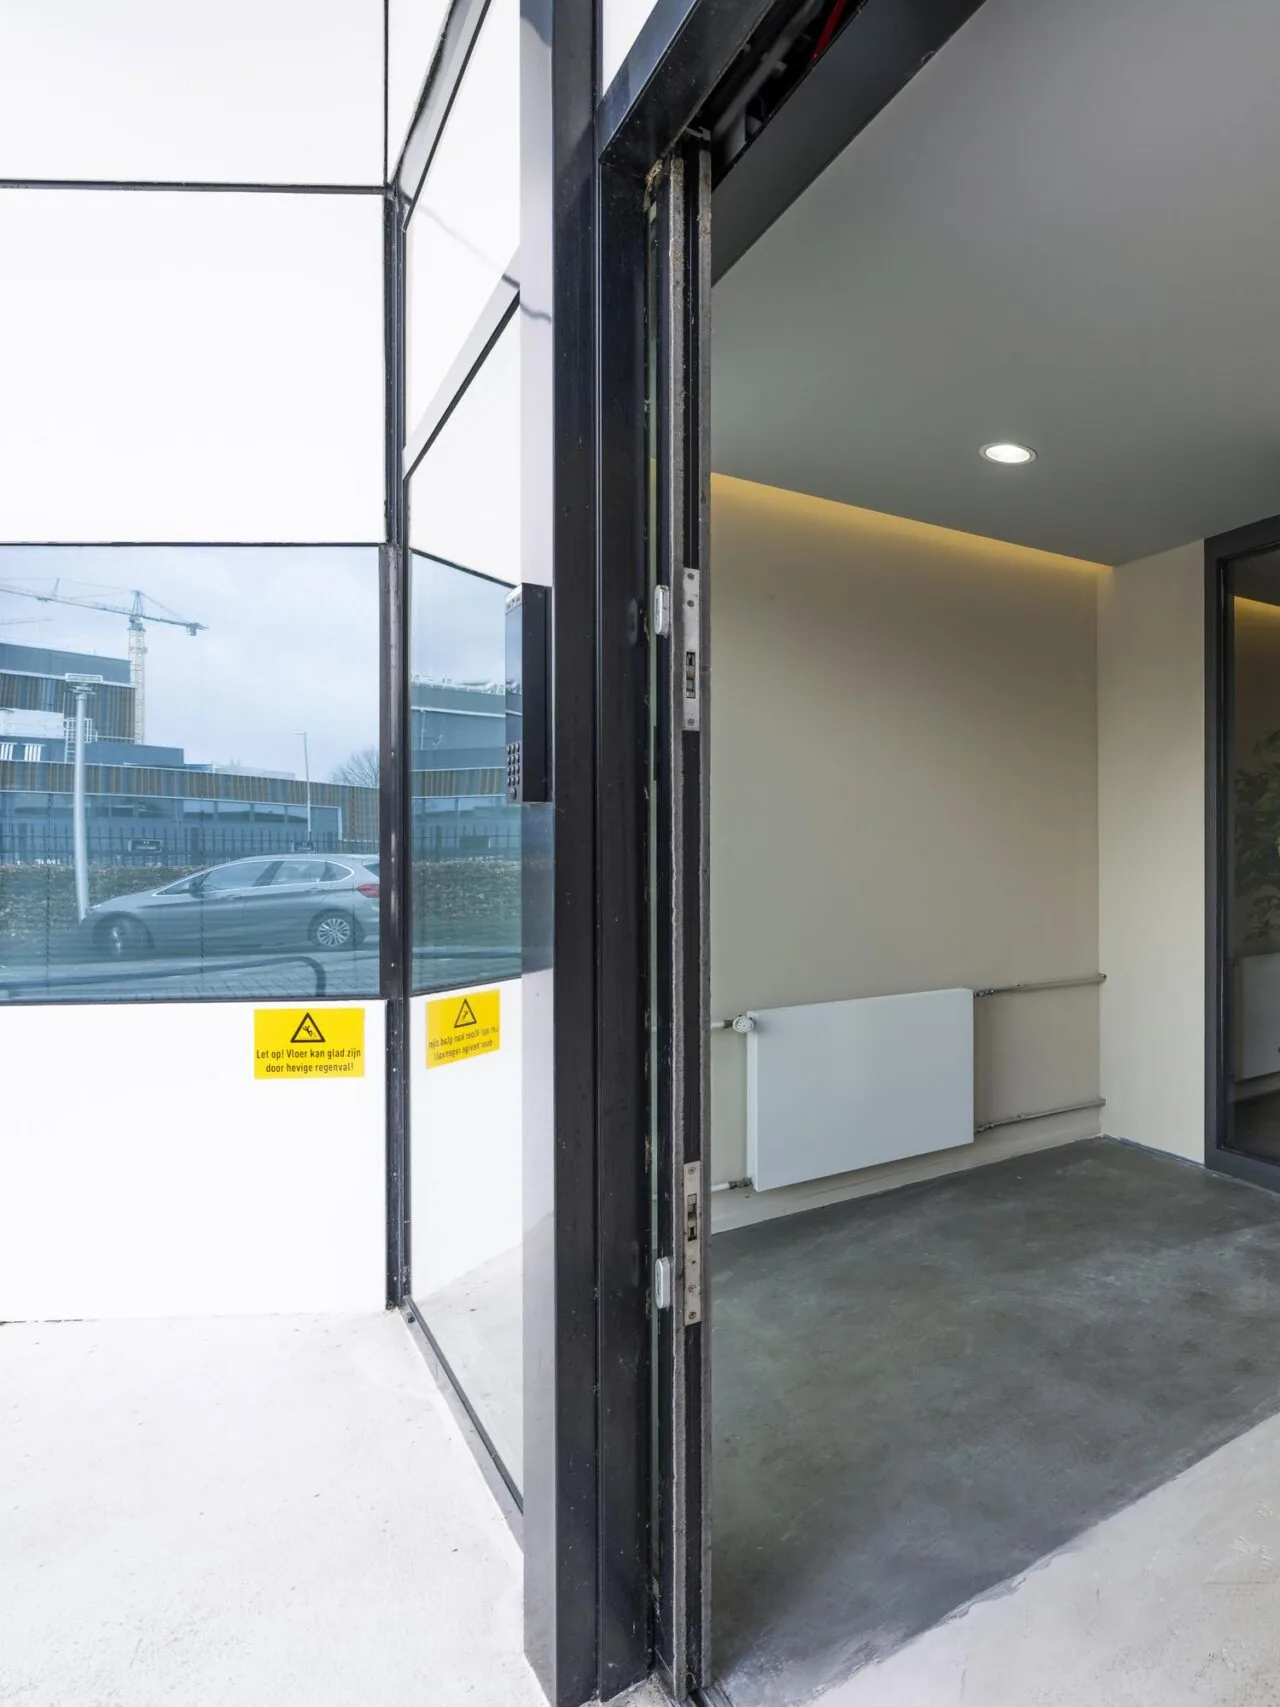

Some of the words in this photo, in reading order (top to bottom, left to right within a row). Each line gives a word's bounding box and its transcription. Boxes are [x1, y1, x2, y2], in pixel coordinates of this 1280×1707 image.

[256, 1049, 269, 1059] Let
[271, 1049, 284, 1060] op!
[286, 1048, 307, 1058] Vloer
[310, 1048, 325, 1058] kan
[327, 1047, 345, 1059] glad
[346, 1048, 361, 1059] zijn
[265, 1063, 284, 1072] door
[286, 1062, 313, 1074] hevige
[315, 1062, 354, 1074] regenval!
